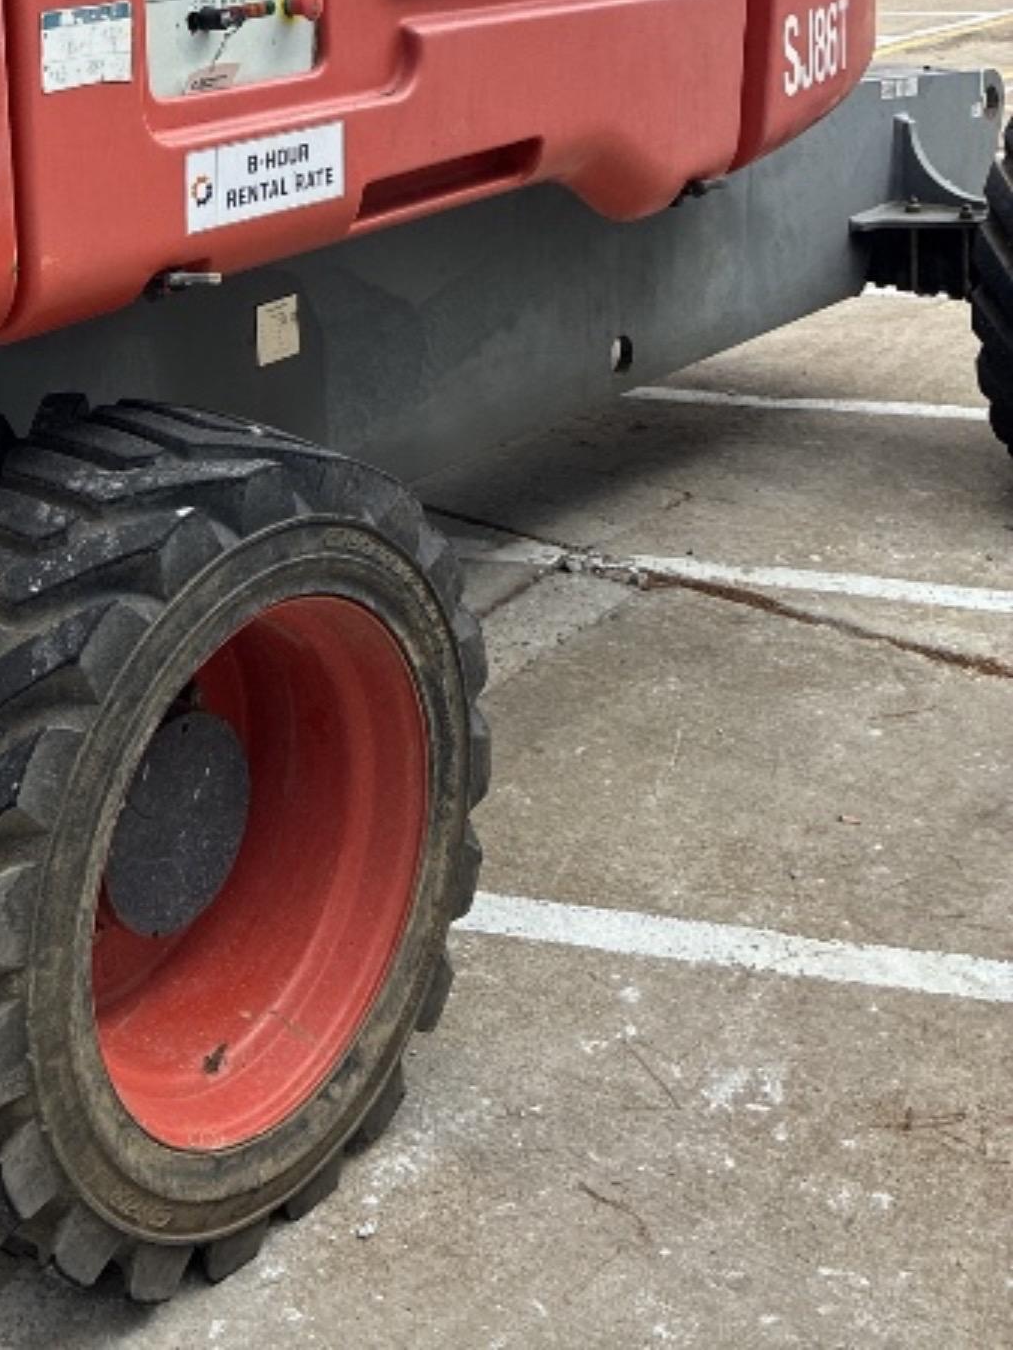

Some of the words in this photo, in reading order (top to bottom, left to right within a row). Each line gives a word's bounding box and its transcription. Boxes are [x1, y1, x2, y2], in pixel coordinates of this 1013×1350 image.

[247, 142, 310, 175] 8-HOUR
[226, 177, 289, 210] RENTAL
[294, 166, 334, 193] RATE
